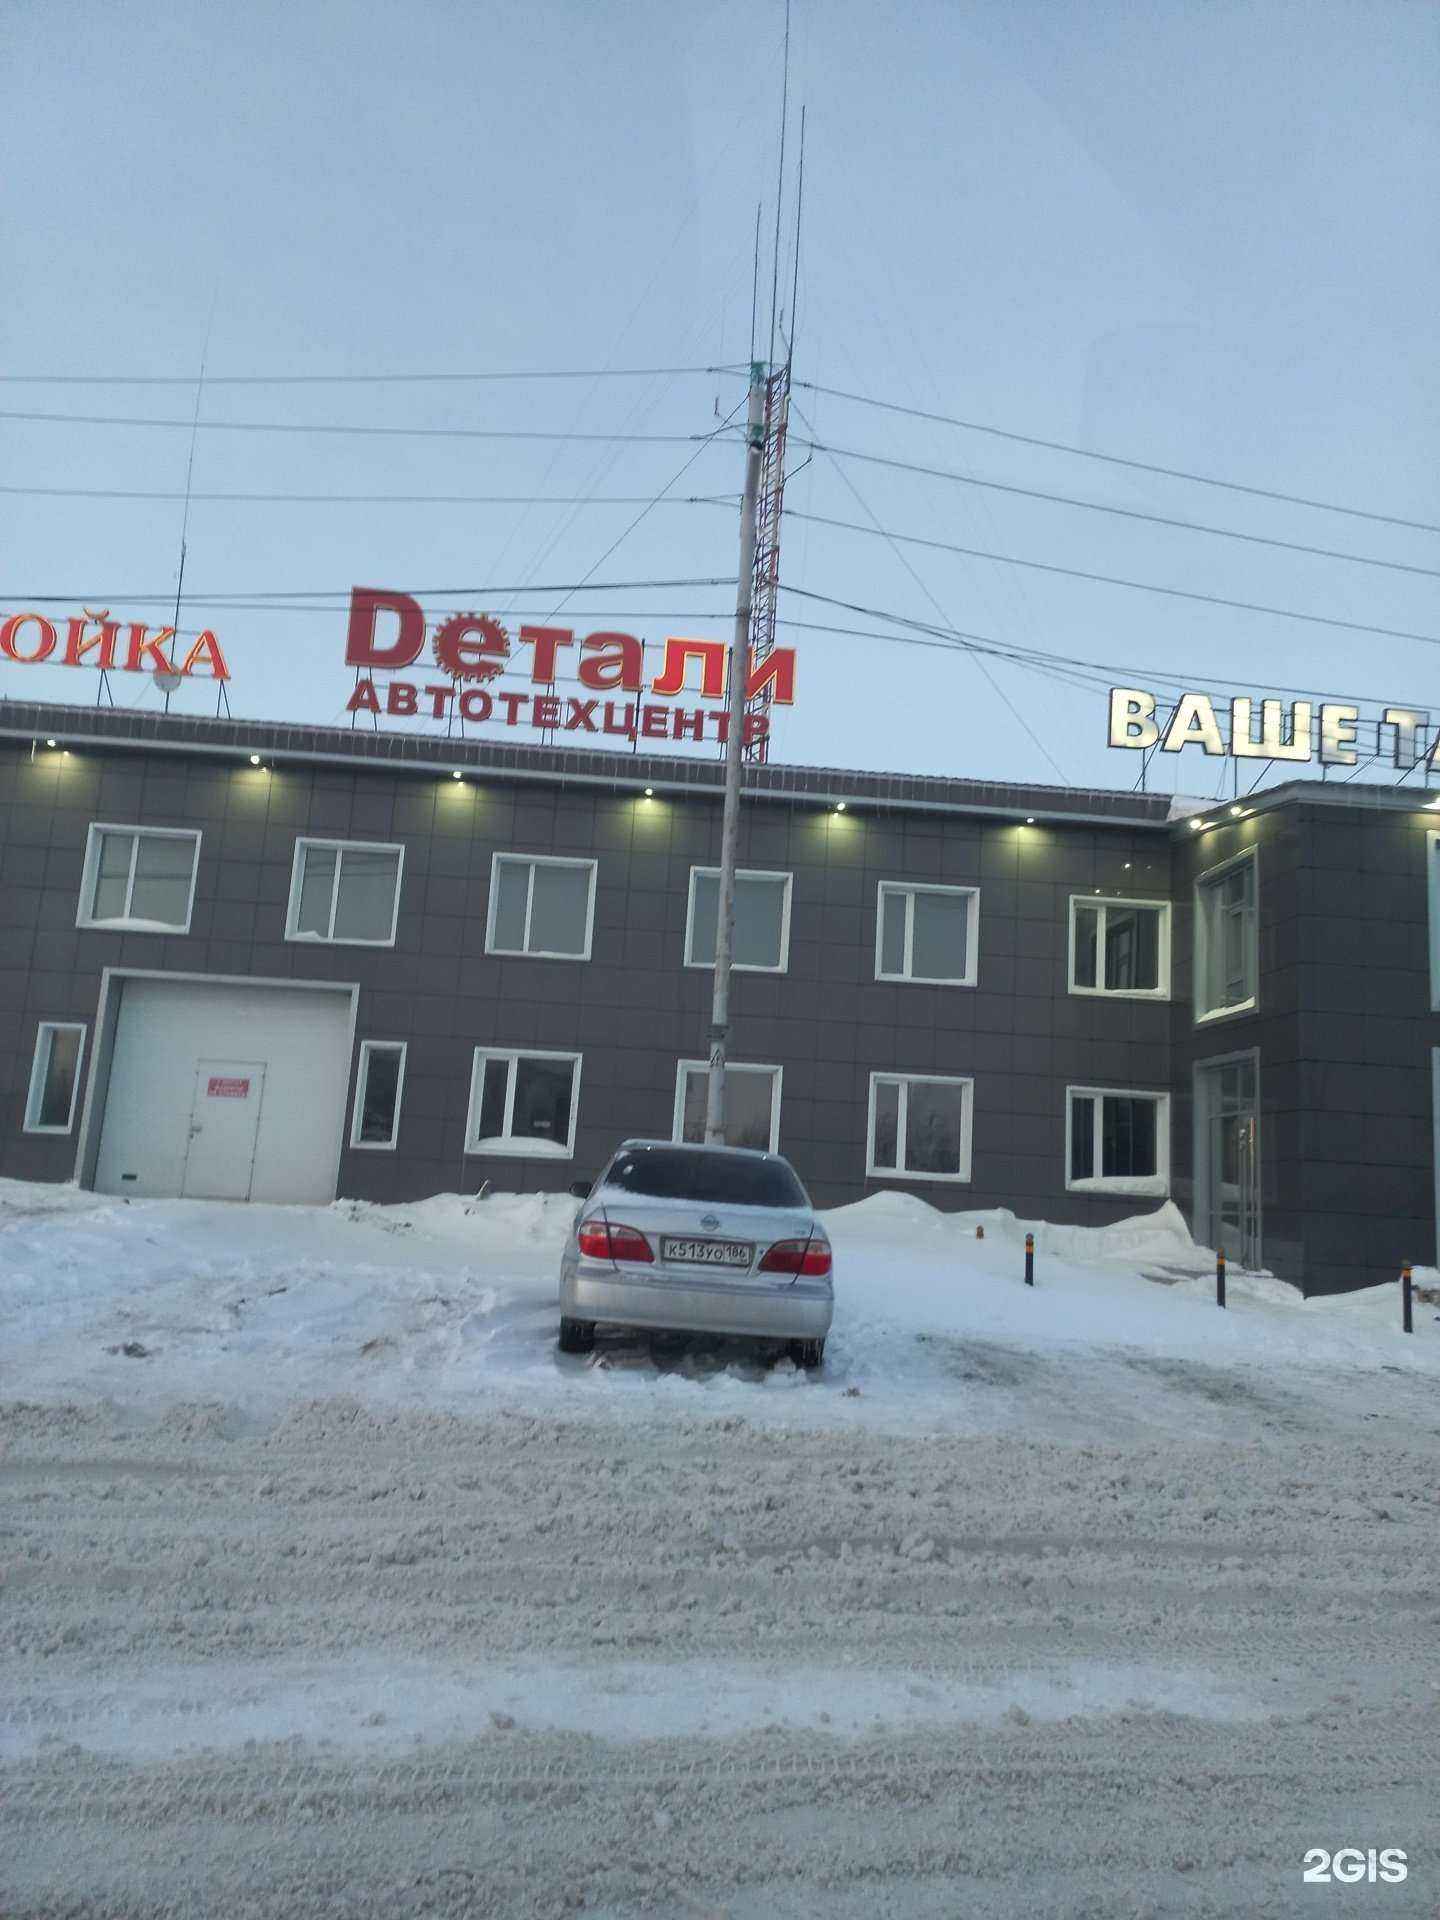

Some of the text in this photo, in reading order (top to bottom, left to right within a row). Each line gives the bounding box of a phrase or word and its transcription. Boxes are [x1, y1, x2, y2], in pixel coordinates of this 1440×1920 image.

[346, 677, 770, 745] АВТОТЕХЦЕНТР
[1107, 687, 1440, 774] ВАШЕ Т
